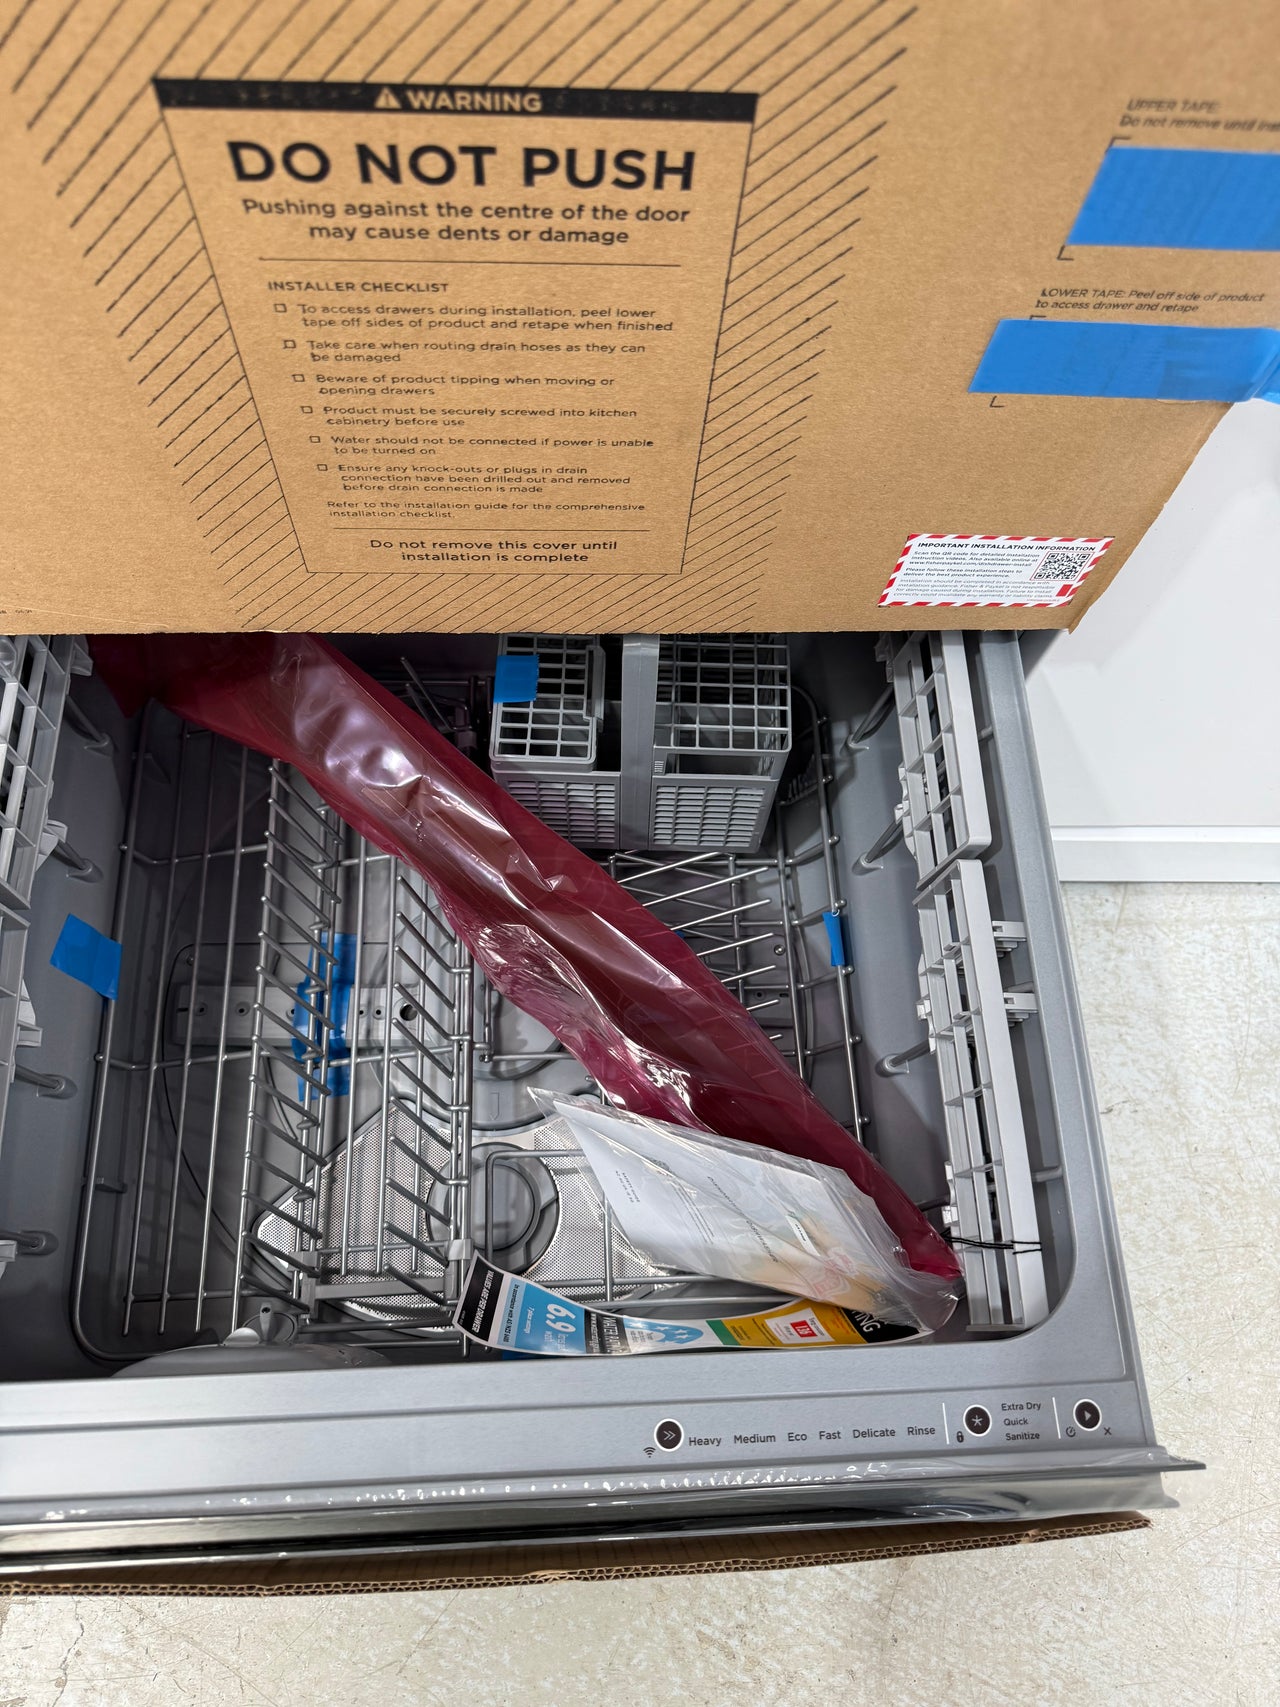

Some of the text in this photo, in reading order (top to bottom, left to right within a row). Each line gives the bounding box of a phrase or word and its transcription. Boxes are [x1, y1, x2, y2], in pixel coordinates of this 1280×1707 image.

[406, 90, 542, 112] WARNING
[1126, 98, 1178, 112] UPPER
[1118, 114, 1141, 127] Do
[1142, 116, 1168, 127] not
[1168, 117, 1223, 130] remove
[1222, 118, 1258, 132] until
[226, 140, 696, 191] DO NOT PUSH
[241, 198, 691, 222] Pushing against the centre of the door
[308, 224, 629, 246] may cause dents or damage
[267, 281, 449, 292] INSTALLER CHECKLIST
[1040, 288, 1089, 297] LOWER
[1128, 290, 1156, 299] Peel
[1155, 291, 1176, 300] off
[1175, 291, 1201, 301] side
[1203, 292, 1218, 301] of
[1217, 292, 1266, 302] product
[298, 303, 317, 314] To
[320, 305, 371, 314] access
[375, 304, 435, 315] drawers
[439, 305, 488, 317] during
[580, 307, 611, 318] peel
[616, 308, 656, 318] lower
[1034, 299, 1199, 314] to access drawer and retape
[301, 317, 674, 331] tape off sides of product and retape when finished
[305, 340, 645, 354] Take care when routing drain hoses as they can
[310, 351, 401, 363] be damaged
[315, 373, 368, 383] Beware
[372, 374, 387, 383] of
[390, 375, 446, 384] product
[450, 375, 499, 385] tipping
[504, 375, 540, 384] when
[543, 376, 596, 387] moving
[318, 386, 435, 396] opening drawers
[323, 406, 637, 417] Product must be securely screwed into kitchen
[326, 417, 390, 427] cabinetry
[394, 417, 438, 425] before
[330, 435, 370, 444] Water
[375, 436, 419, 444] should
[448, 437, 465, 445] be
[468, 437, 537, 445] connected
[552, 439, 593, 447] power
[597, 438, 607, 446] is
[611, 439, 654, 447] unable
[337, 464, 381, 472] Ensure
[410, 464, 482, 473] knock-outs
[503, 466, 537, 475] plugs
[556, 466, 587, 474] drain
[341, 474, 411, 482] connection
[483, 475, 522, 483] drilled
[577, 476, 630, 484] removed
[342, 483, 384, 491] before
[388, 483, 419, 491] drain
[509, 485, 543, 493] made
[404, 501, 470, 509] installation
[474, 502, 508, 510] guide
[511, 502, 528, 510] for
[555, 503, 645, 511] comprehensive
[329, 510, 455, 519] installation checklist.
[370, 539, 393, 548] Do
[399, 540, 426, 548] not
[498, 540, 527, 549] this
[532, 542, 577, 550] cover
[582, 541, 617, 549] until
[401, 551, 588, 563] installation is complete
[471, 1270, 495, 1333] VALUES ARE PER DRAWER
[545, 1303, 577, 1333] 6.9
[1000, 1401, 1041, 1411] Extra Dry
[1003, 1417, 1028, 1426] Quick
[688, 1426, 935, 1447] Heavy Medium Eco Fast Delicate Rinse
[1005, 1431, 1040, 1441] Sanitize
